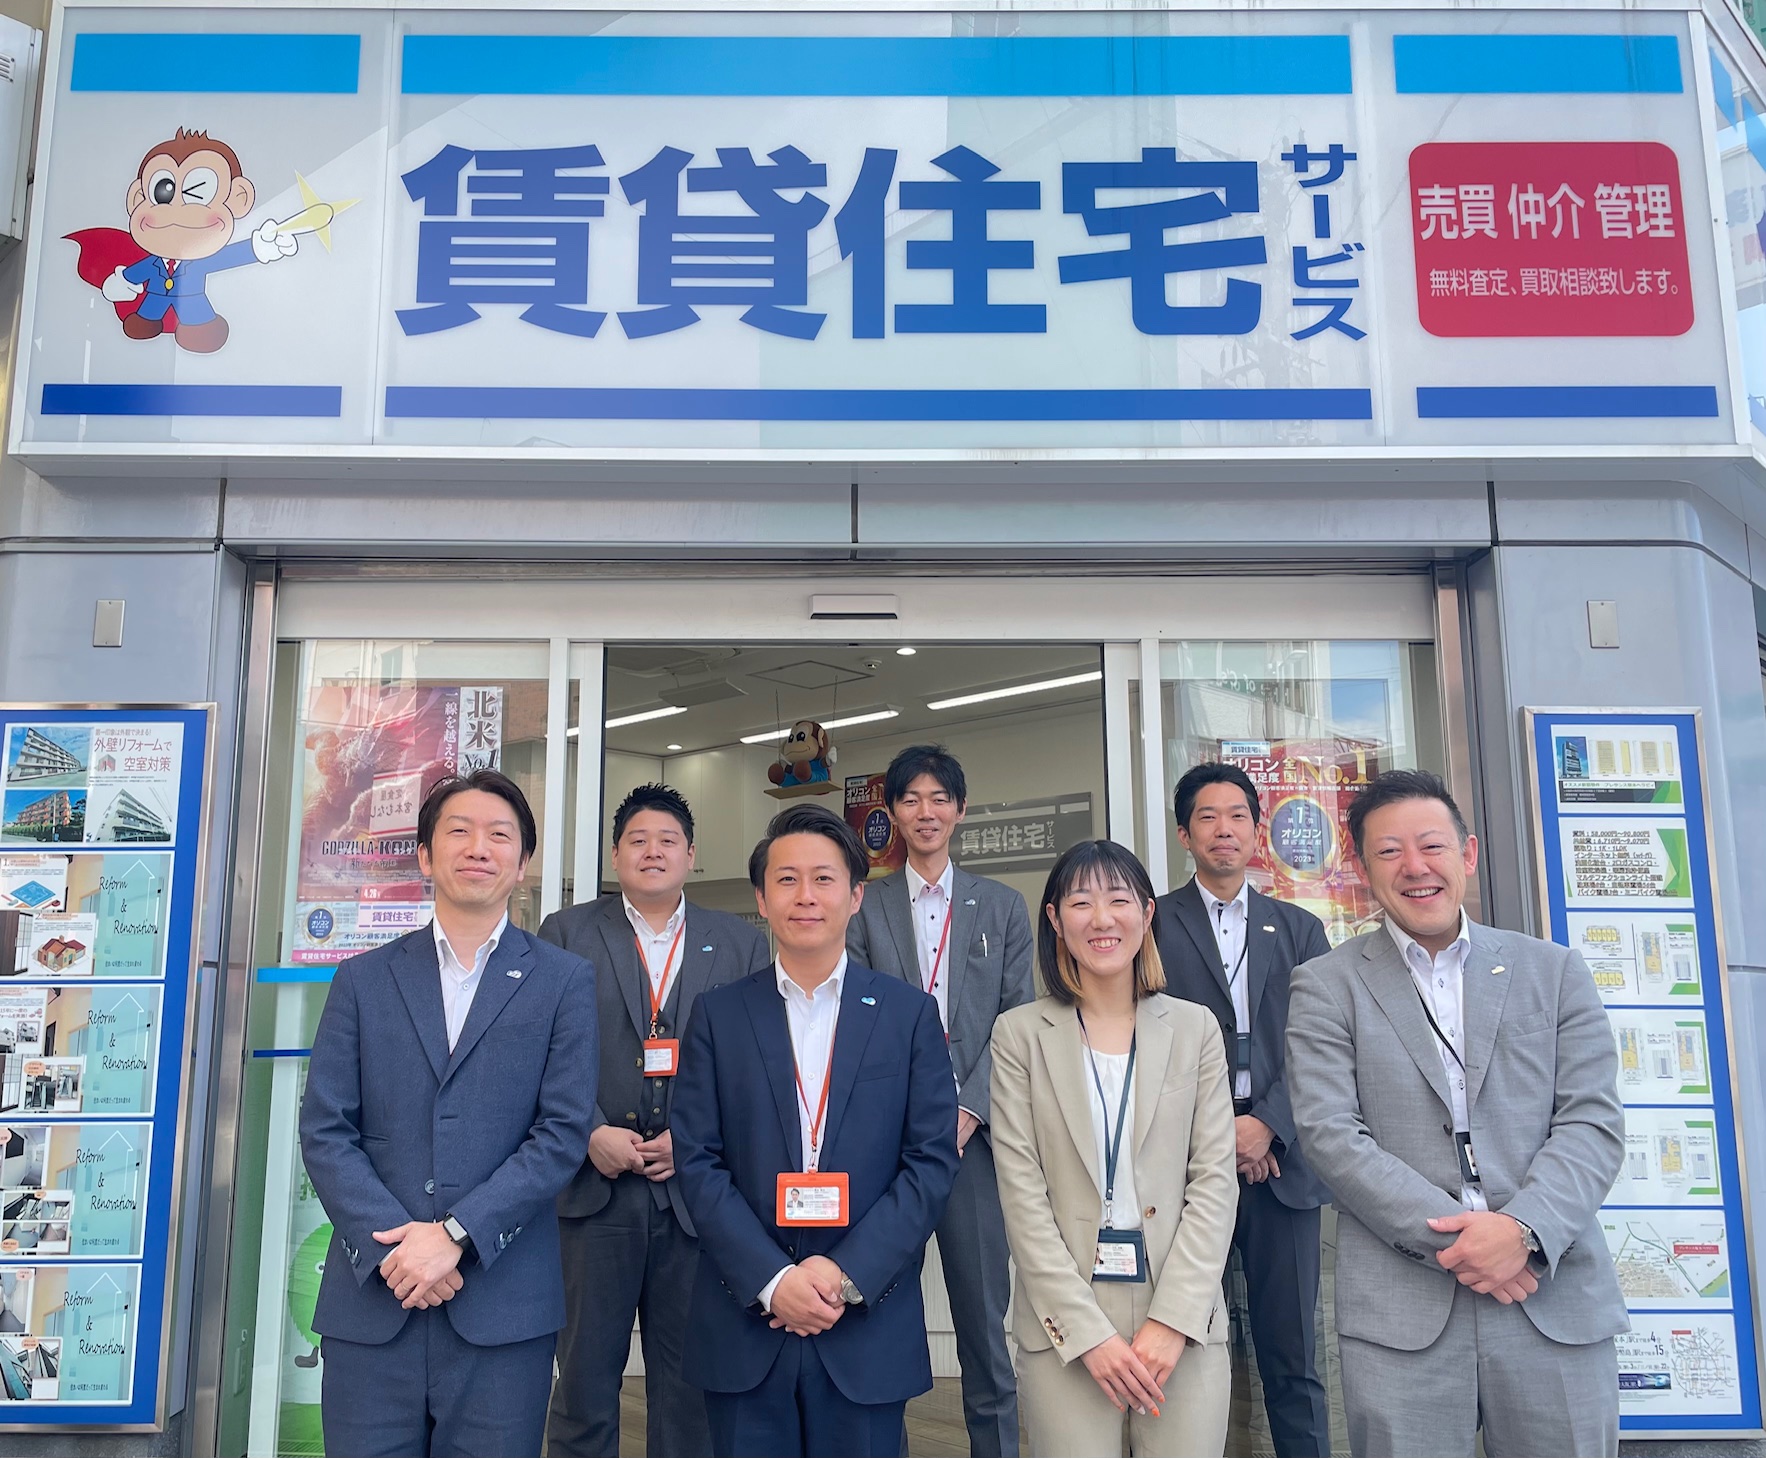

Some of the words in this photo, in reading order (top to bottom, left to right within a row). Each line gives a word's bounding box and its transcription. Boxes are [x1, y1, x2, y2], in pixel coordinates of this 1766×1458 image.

[1418, 183, 1498, 240] 売買
[1508, 183, 1585, 240] 仲介
[1593, 183, 1675, 239] 管理
[395, 144, 1267, 341] 賃貸住宅
[1281, 144, 1367, 341] サービス
[1430, 268, 1678, 297] 無料査定、買取相談致します。
[444, 692, 459, 773] 一線を越える。
[94, 737, 172, 752] 外壁リフォームで
[124, 757, 172, 772] 空室対策
[1283, 758, 1297, 783] 全国
[1297, 748, 1374, 784] No.1
[961, 823, 1045, 856] 賃貸住宅
[1046, 821, 1055, 849] サービス
[1281, 828, 1322, 838] オリコン
[99, 876, 128, 894] Reform
[120, 898, 127, 913] &
[372, 912, 413, 922] 賃貸住宅
[114, 919, 158, 935] Renovation
[301, 952, 359, 960] 賃貸住宅サービスは
[87, 1009, 117, 1029] Reform
[109, 1032, 116, 1048] &
[102, 1055, 148, 1070] Renovation
[76, 1148, 105, 1168] Reform
[98, 1172, 105, 1188] &
[91, 1194, 137, 1211] Renovation
[64, 1291, 93, 1311] Reform
[86, 1315, 93, 1331] &
[79, 1338, 126, 1355] Renovation
